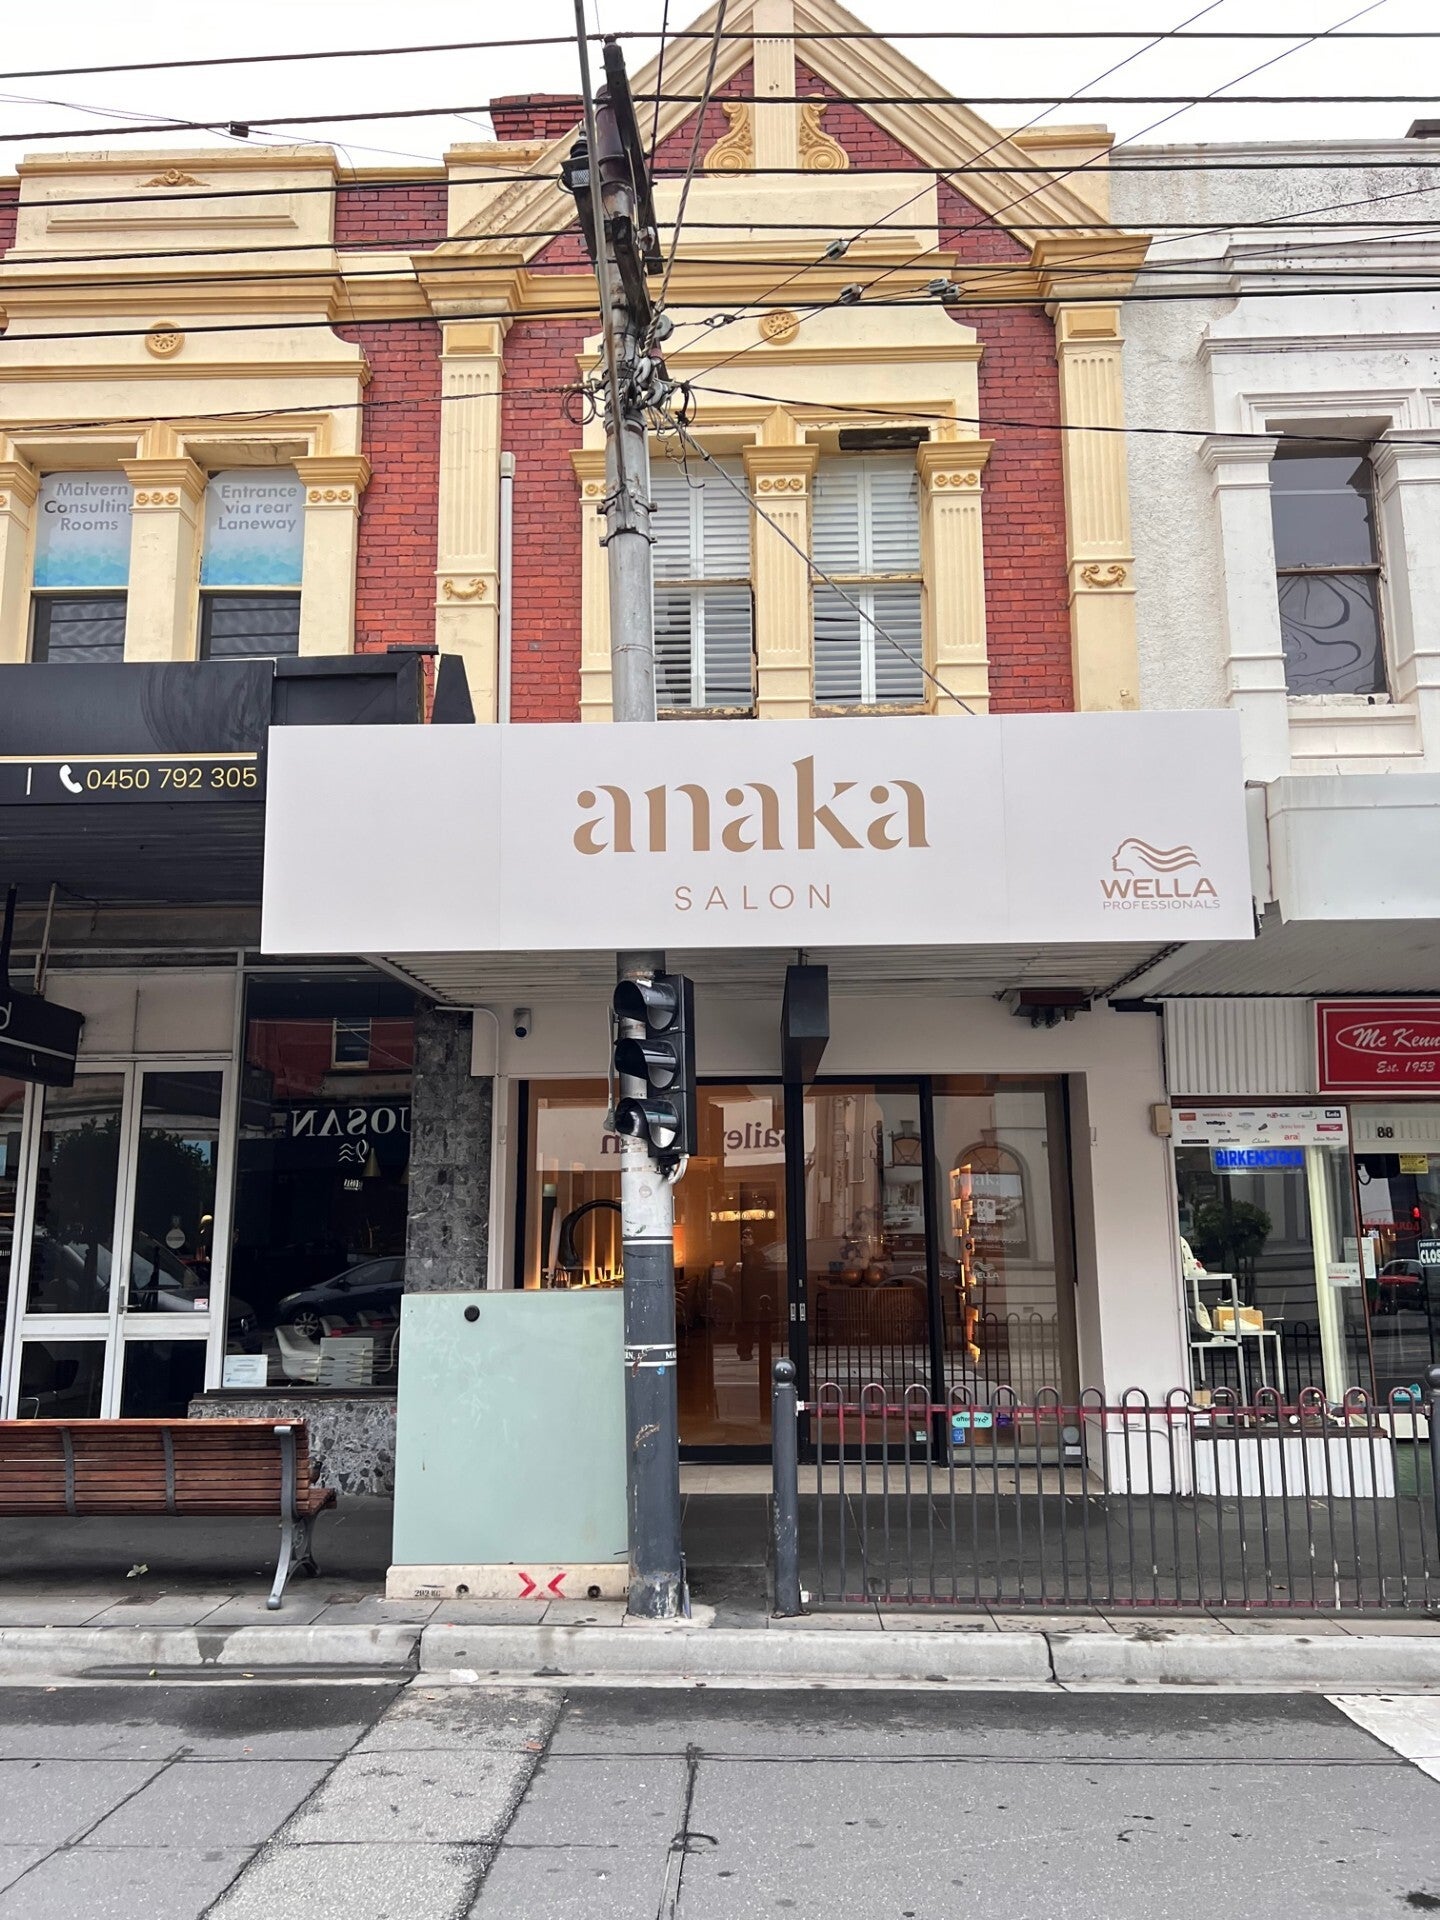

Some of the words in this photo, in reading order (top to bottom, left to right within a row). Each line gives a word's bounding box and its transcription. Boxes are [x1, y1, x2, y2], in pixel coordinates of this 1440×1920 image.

[56, 482, 128, 497] Malvern
[221, 484, 297, 499] Entrance
[225, 500, 251, 514] via
[256, 501, 293, 514] rear
[60, 517, 119, 531] Rooms
[218, 517, 297, 532] Laneway
[86, 769, 150, 790] 0450
[158, 767, 203, 789] 792
[210, 767, 257, 788] 305
[573, 754, 931, 855] anaka
[1100, 877, 1218, 899] WELLA
[674, 884, 831, 911] SALON
[1103, 899, 1221, 911] PROFESSIONALS
[1376, 1061, 1400, 1074] Est.
[1405, 1060, 1436, 1073] 1953
[1376, 1126, 1394, 1139] 88
